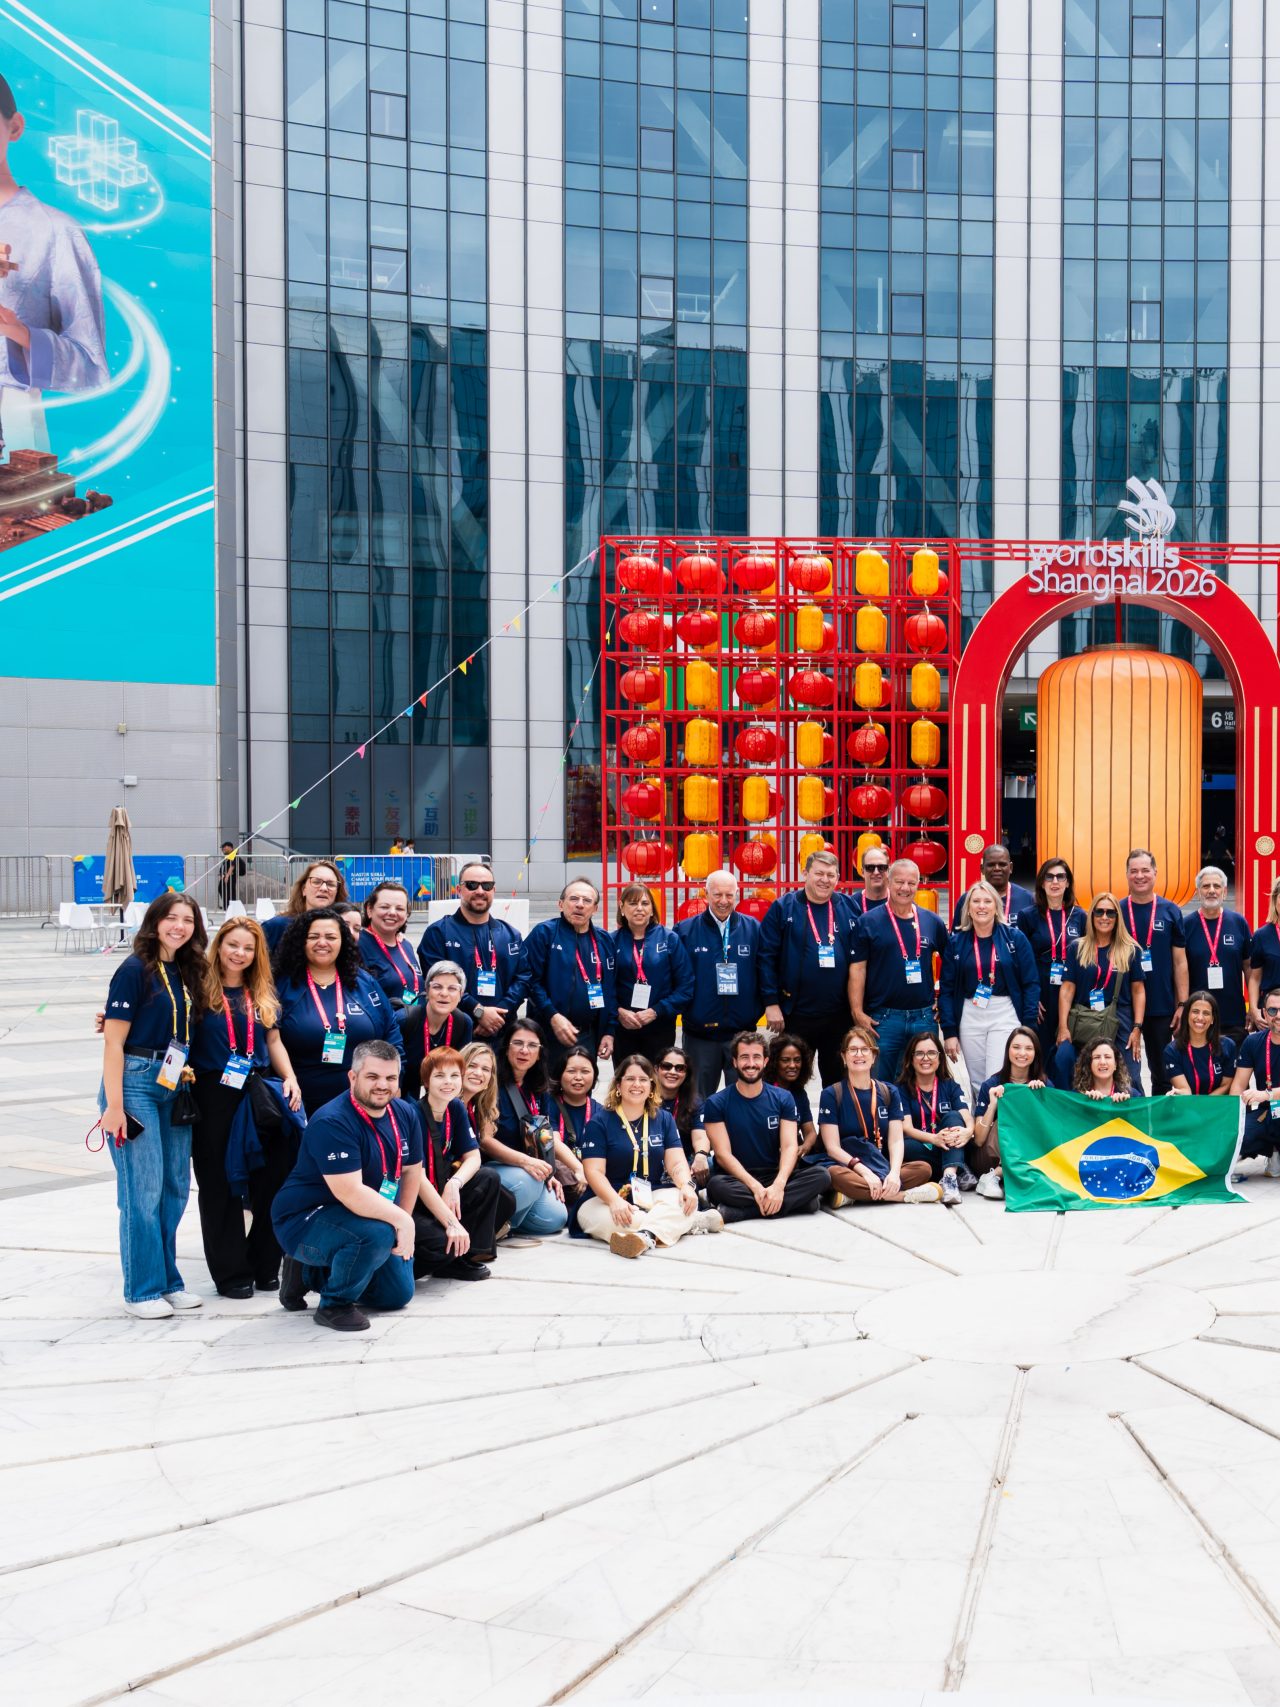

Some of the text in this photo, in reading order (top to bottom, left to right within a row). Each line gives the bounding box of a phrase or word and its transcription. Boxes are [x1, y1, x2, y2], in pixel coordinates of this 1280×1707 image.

[1028, 537, 1180, 568] worldskills
[1028, 563, 1217, 600] Shanghai 2026
[1211, 711, 1222, 728] 6
[424, 807, 440, 836] 互助
